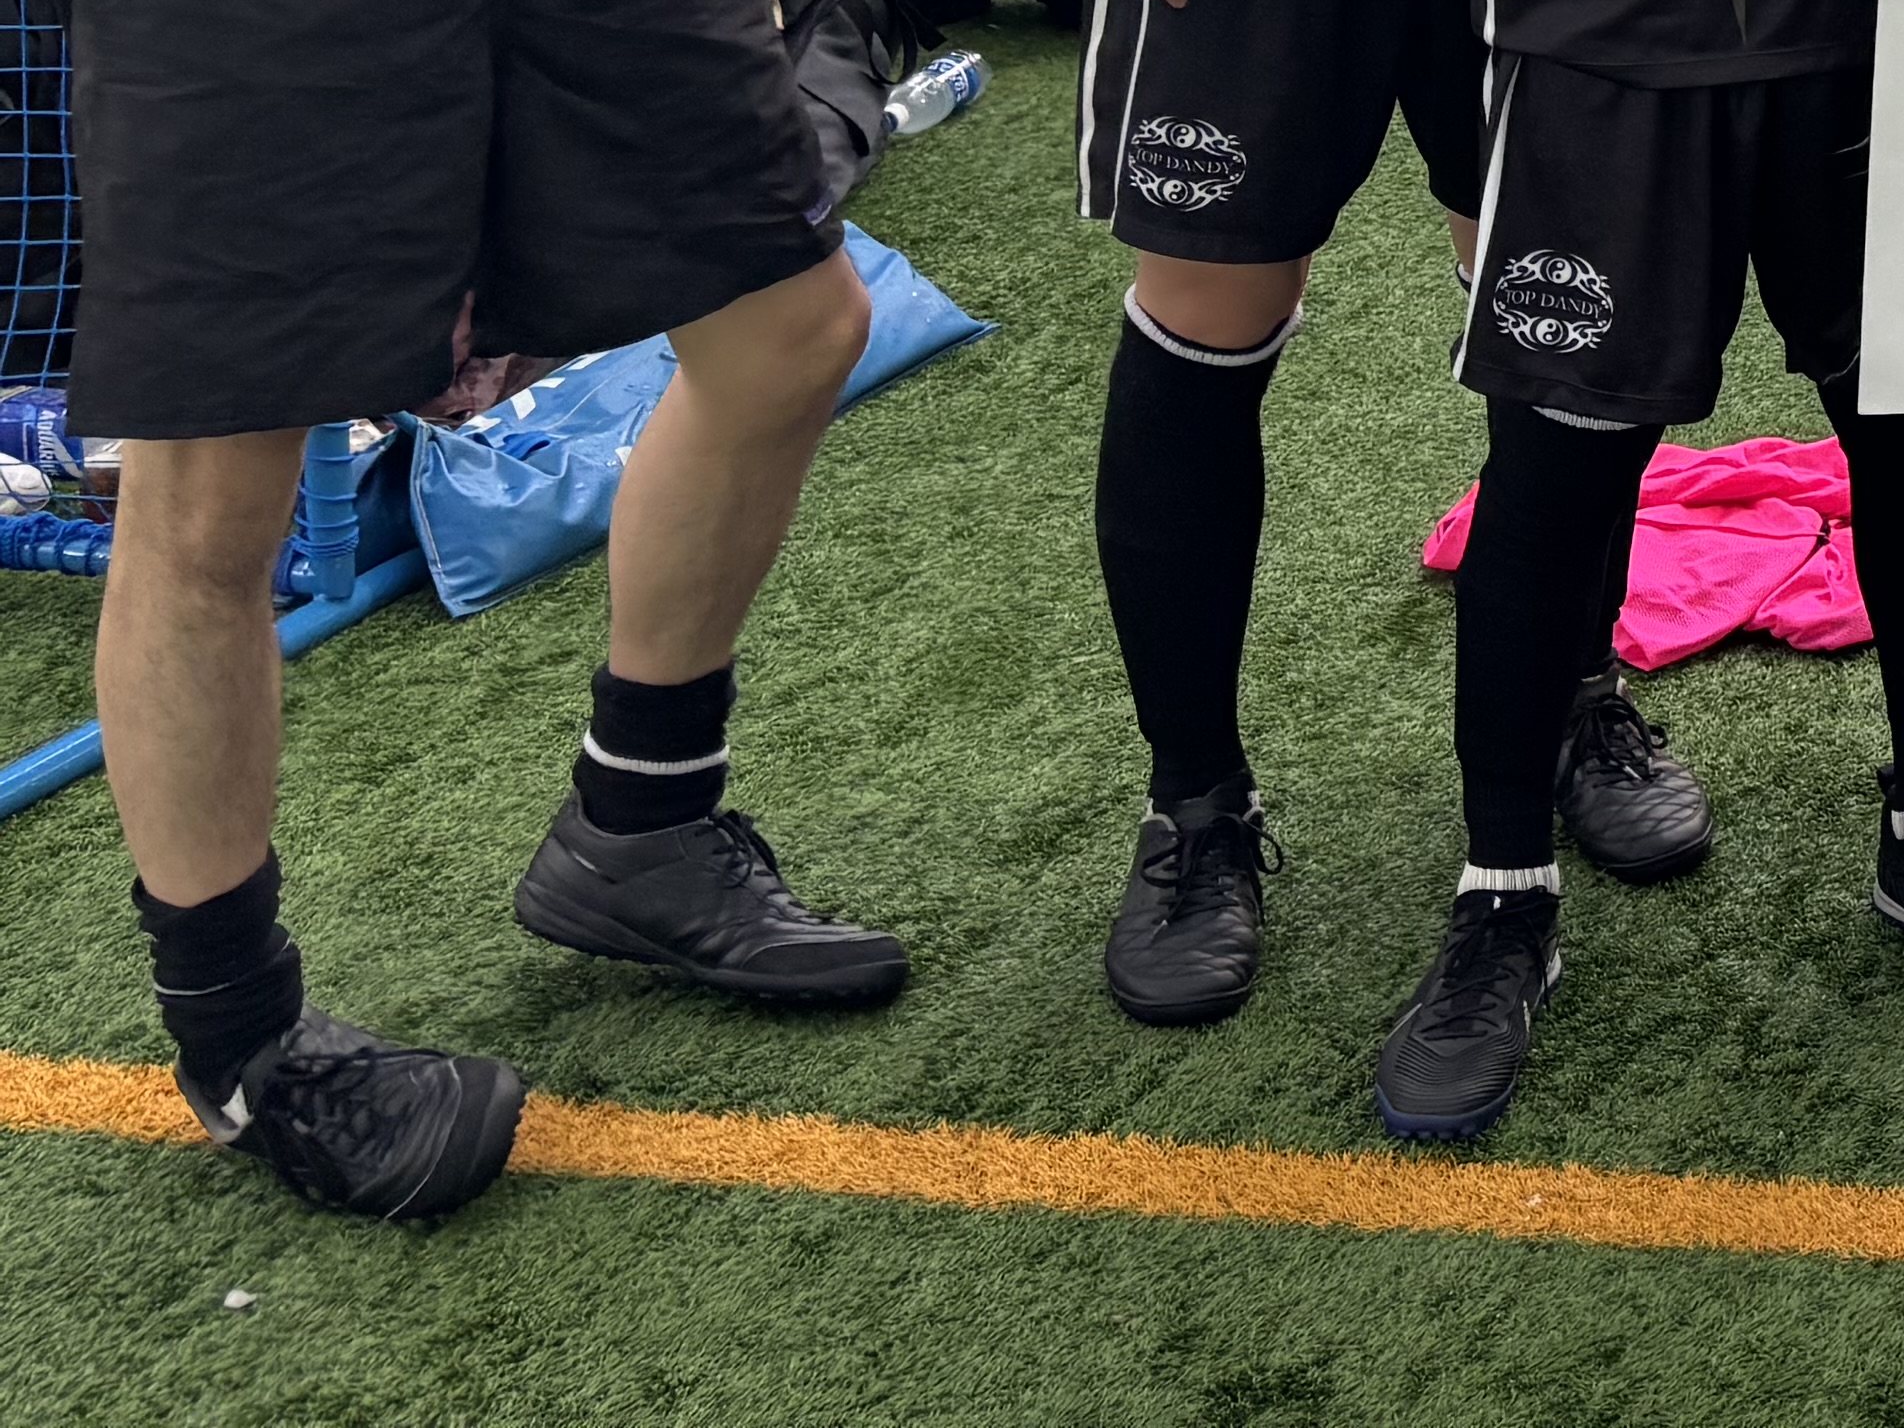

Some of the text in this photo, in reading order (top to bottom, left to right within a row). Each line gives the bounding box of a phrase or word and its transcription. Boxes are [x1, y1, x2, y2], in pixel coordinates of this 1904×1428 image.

[1167, 155, 1232, 175] DANDY
[1505, 288, 1602, 319] TOP DANDY
